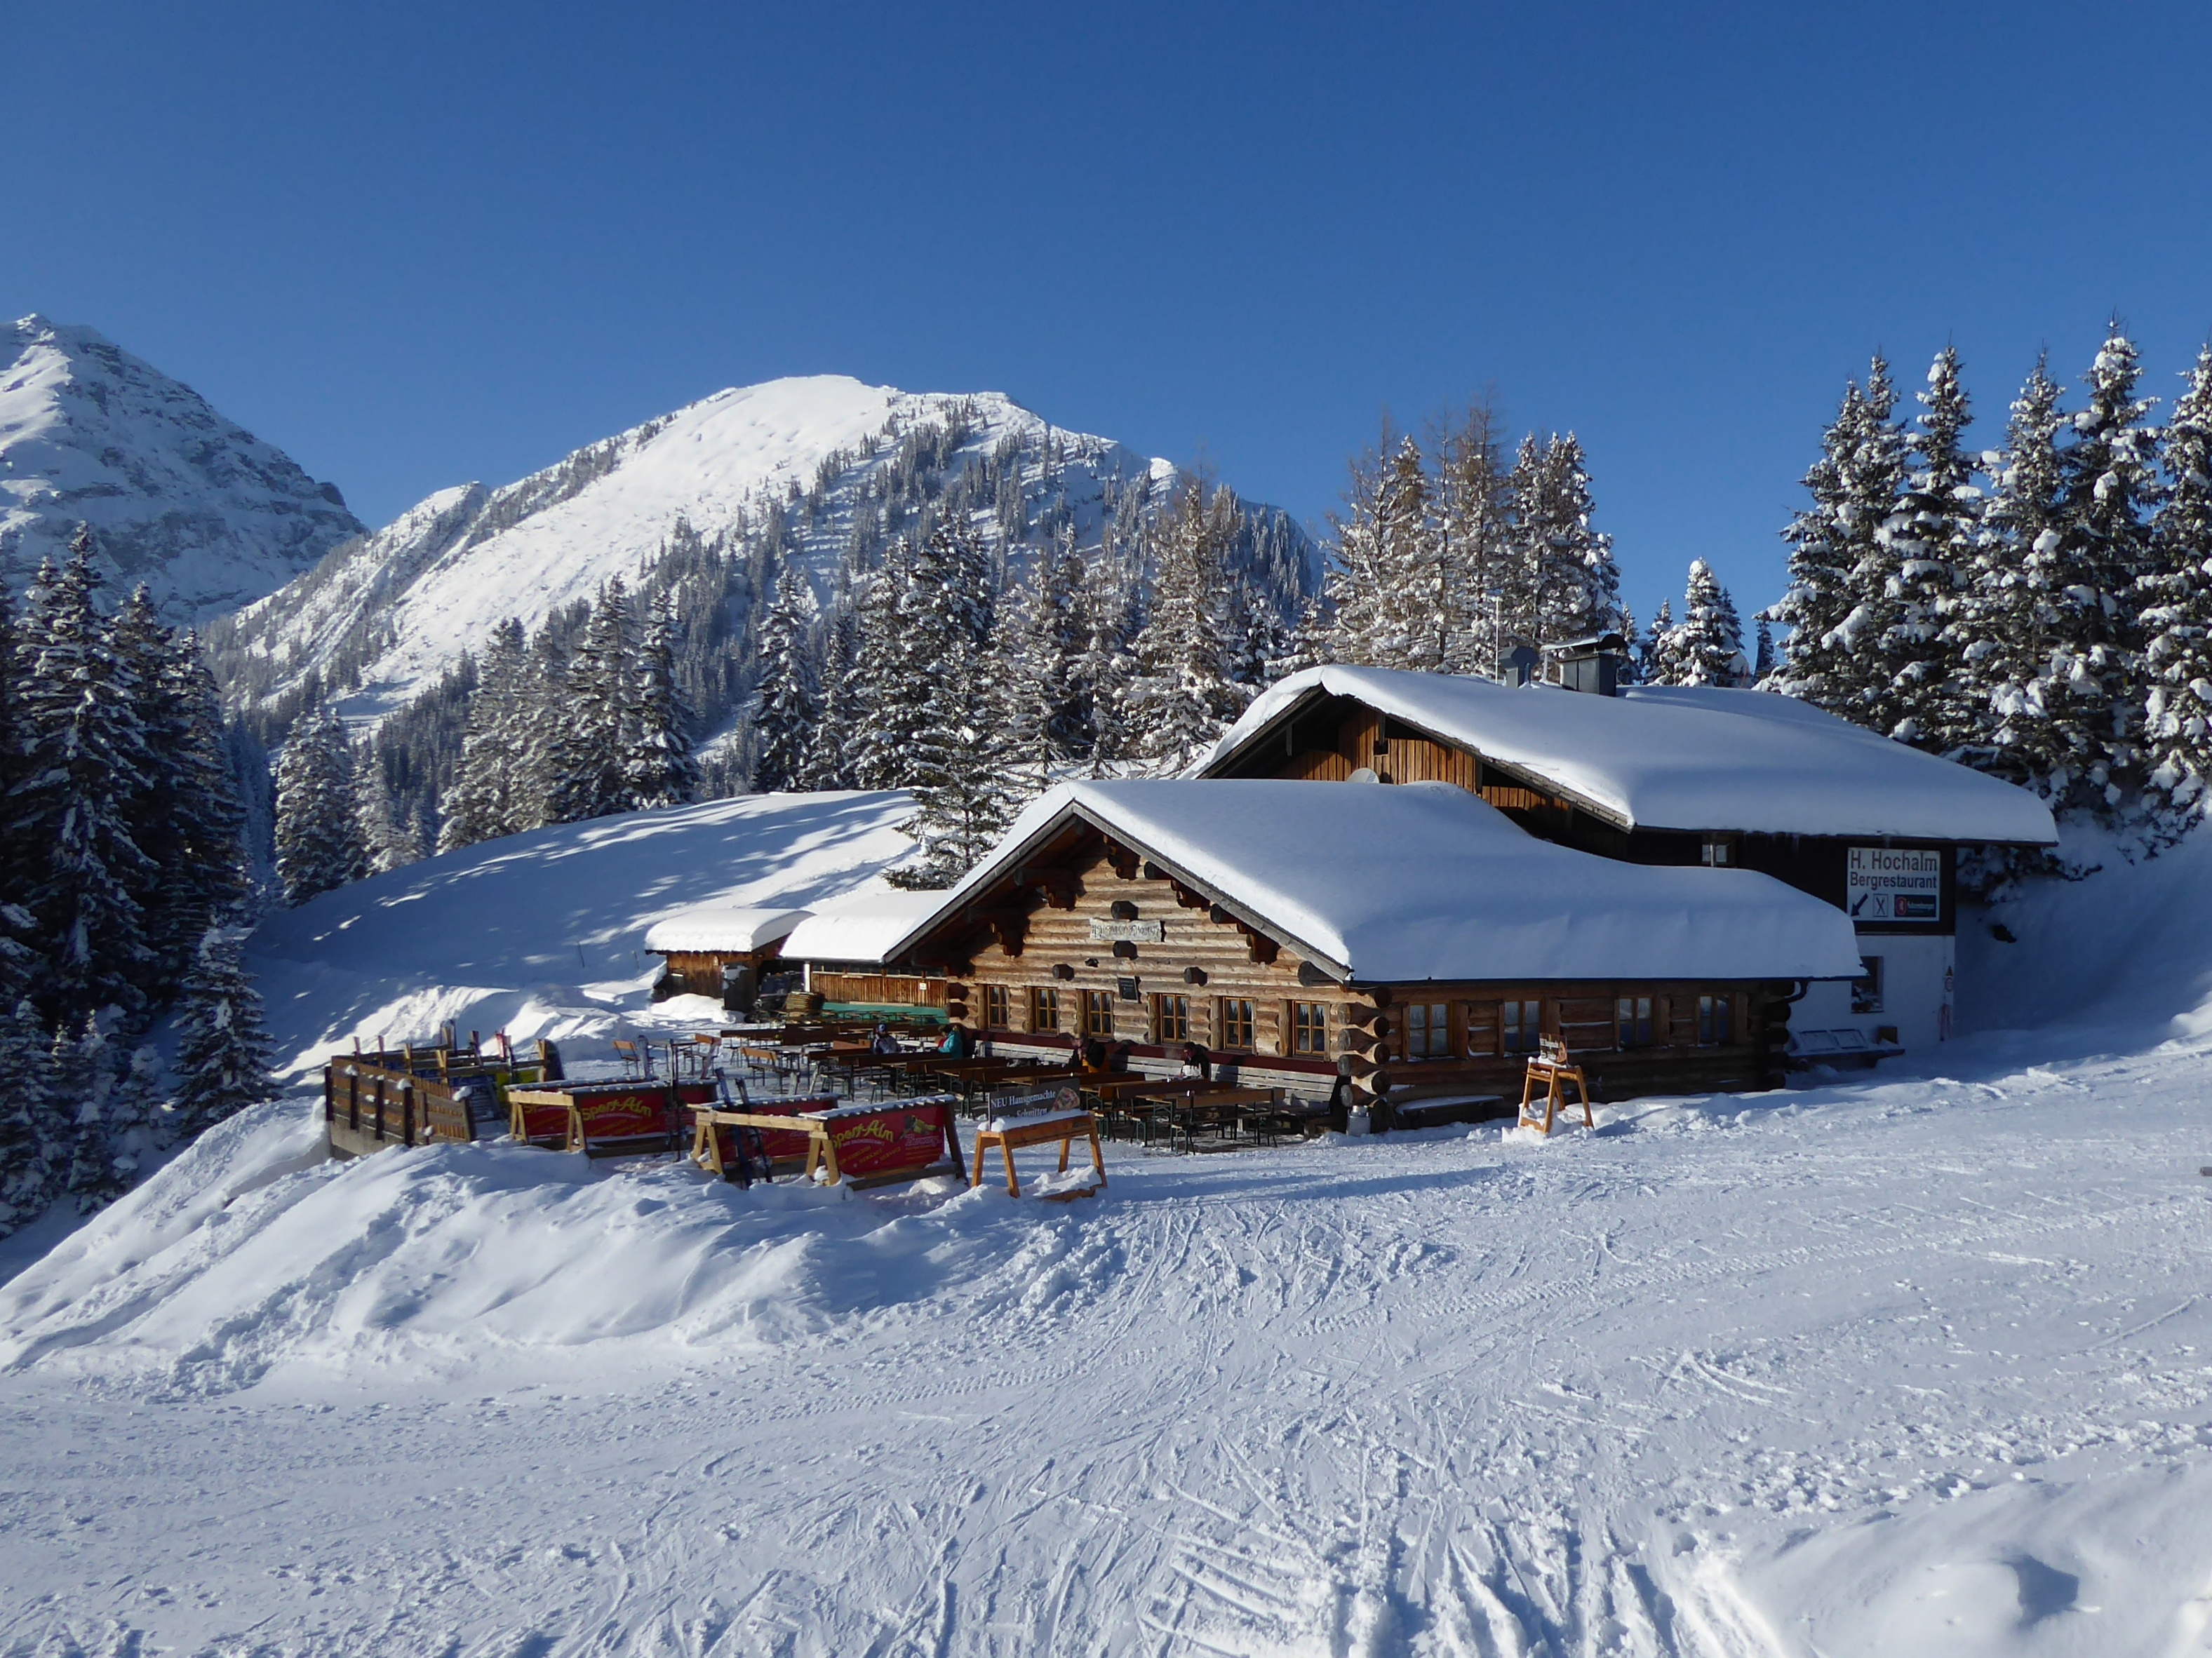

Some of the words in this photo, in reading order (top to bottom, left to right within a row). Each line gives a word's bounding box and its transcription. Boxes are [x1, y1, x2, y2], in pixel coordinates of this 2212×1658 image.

[1850, 850, 1865, 870] H.
[1872, 850, 1938, 872] Hochalm
[1849, 871, 1937, 891] Bergrestaurant
[990, 1096, 1008, 1108] NEU
[1010, 1089, 1057, 1105] Hausgemachte
